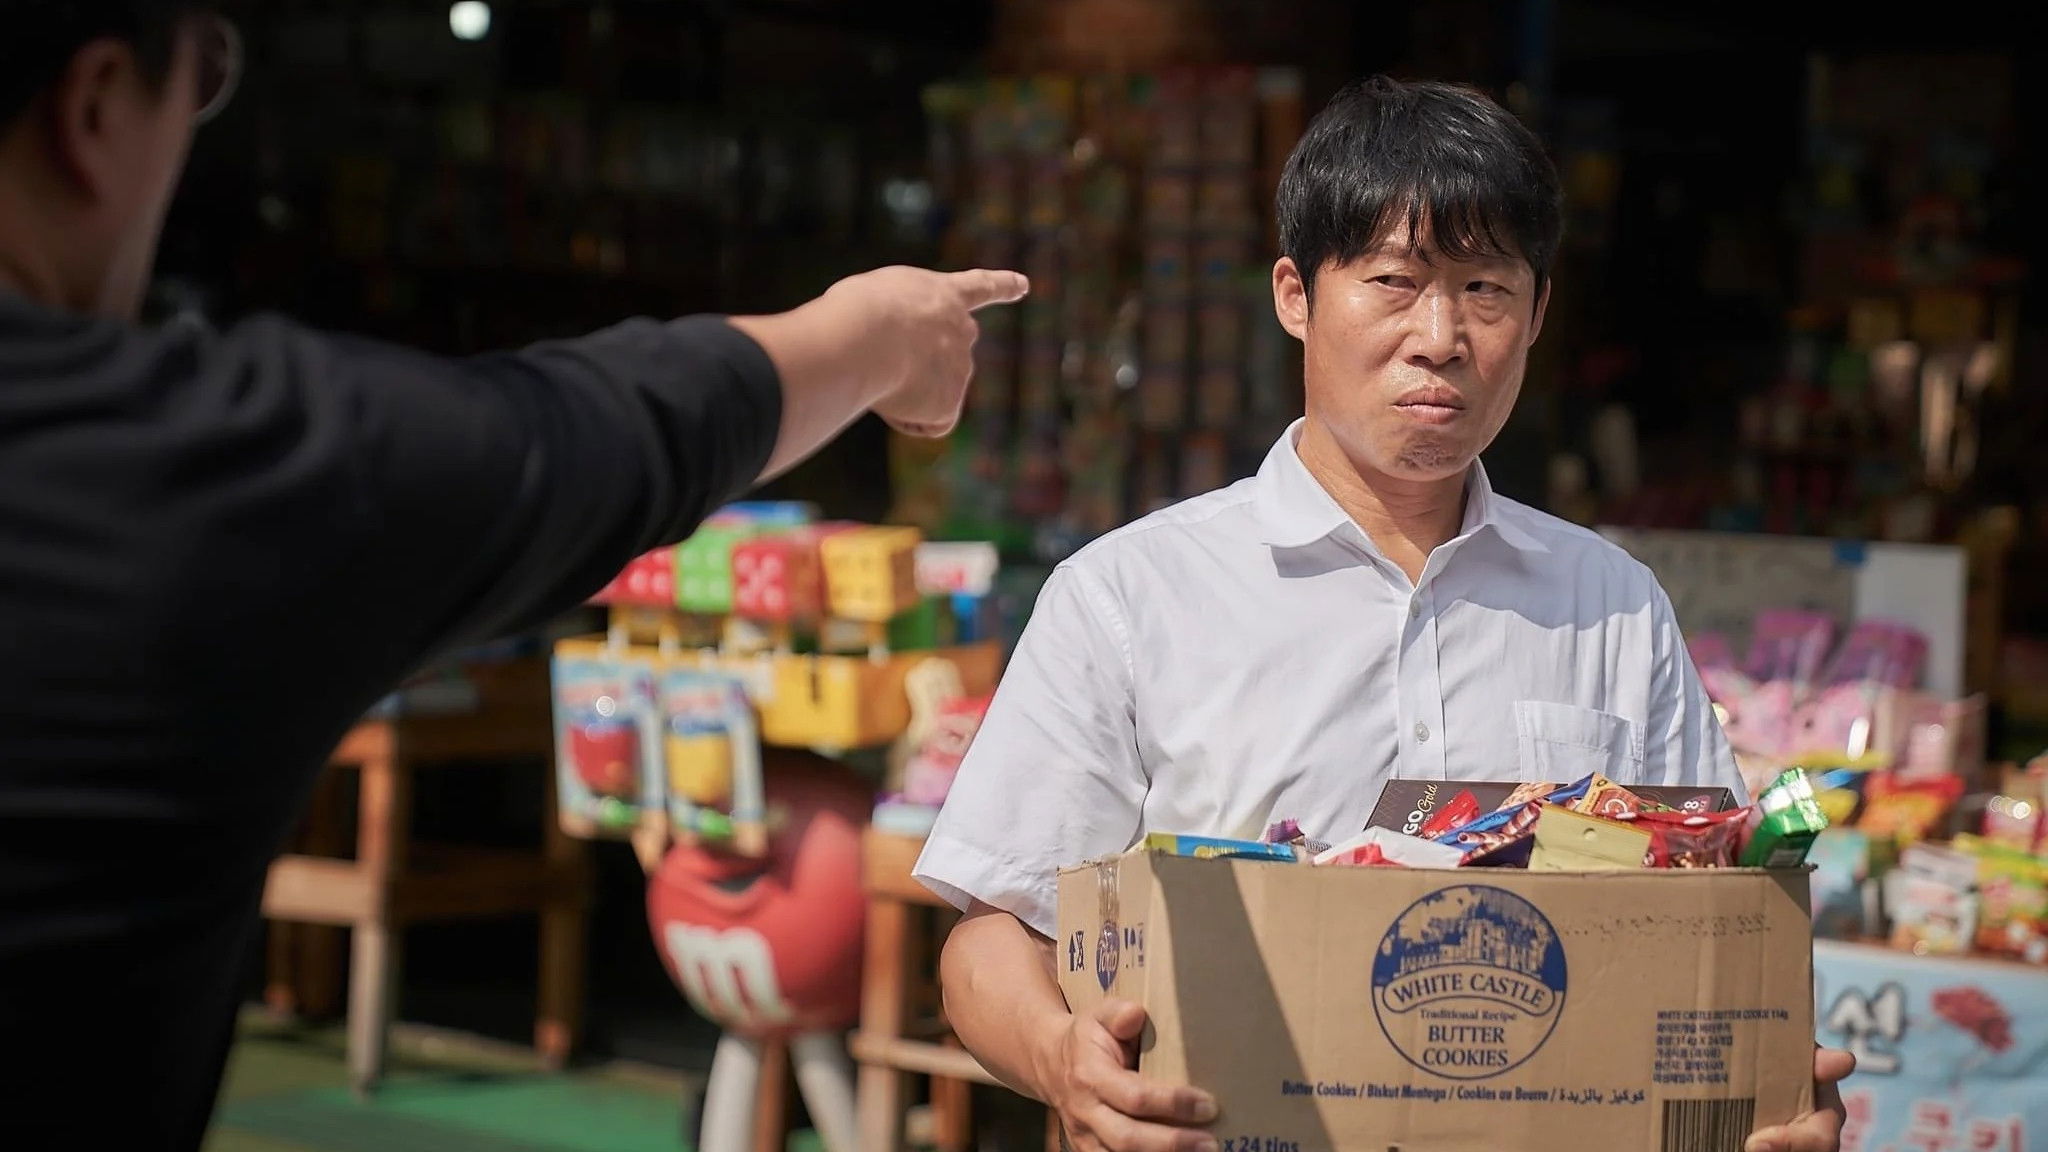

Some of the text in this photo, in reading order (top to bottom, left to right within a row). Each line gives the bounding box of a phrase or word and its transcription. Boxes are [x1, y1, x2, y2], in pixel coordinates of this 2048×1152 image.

[1417, 784, 1437, 812] Gold
[663, 920, 793, 1025] m
[1392, 973, 1545, 1008] WHITE CASTLE
[1420, 1008, 1517, 1024] Traditional Recipe
[1656, 1010, 1681, 1020] WHITE
[1682, 1010, 1712, 1020] CASTLE
[1713, 1009, 1741, 1020] BUTTER
[1428, 1025, 1505, 1043] BUTTER
[1422, 1047, 1508, 1067] COOKIES
[1281, 1080, 1313, 1096] Butter
[1316, 1081, 1357, 1097] Cookies
[1367, 1083, 1400, 1098] Biskut
[1457, 1085, 1496, 1101] Cookies
[1499, 1088, 1513, 1101] au
[1515, 1086, 1549, 1101] Beurre
[1239, 1135, 1260, 1152] 24
